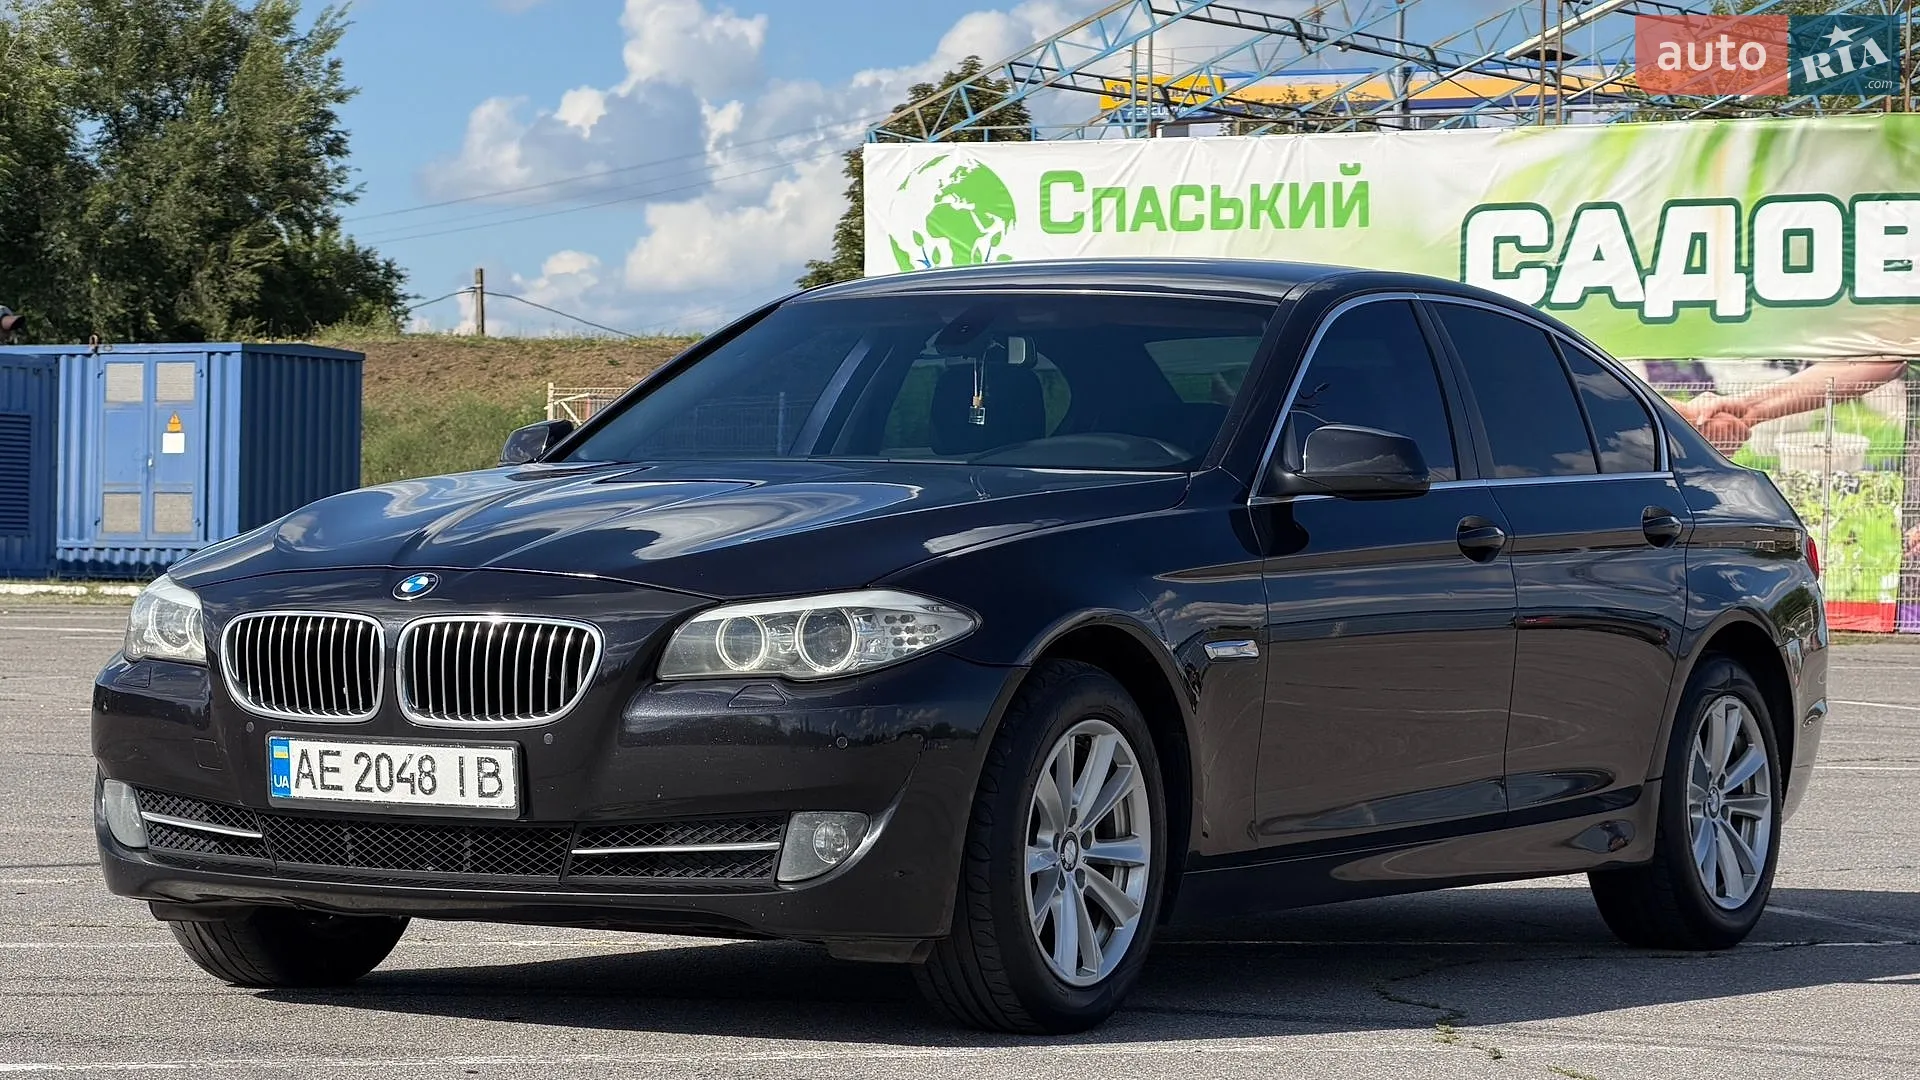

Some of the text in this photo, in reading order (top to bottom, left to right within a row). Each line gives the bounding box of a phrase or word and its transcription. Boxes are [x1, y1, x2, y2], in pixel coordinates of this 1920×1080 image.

[273, 774, 290, 789] UA
[294, 748, 503, 799] AE 2048 IB
